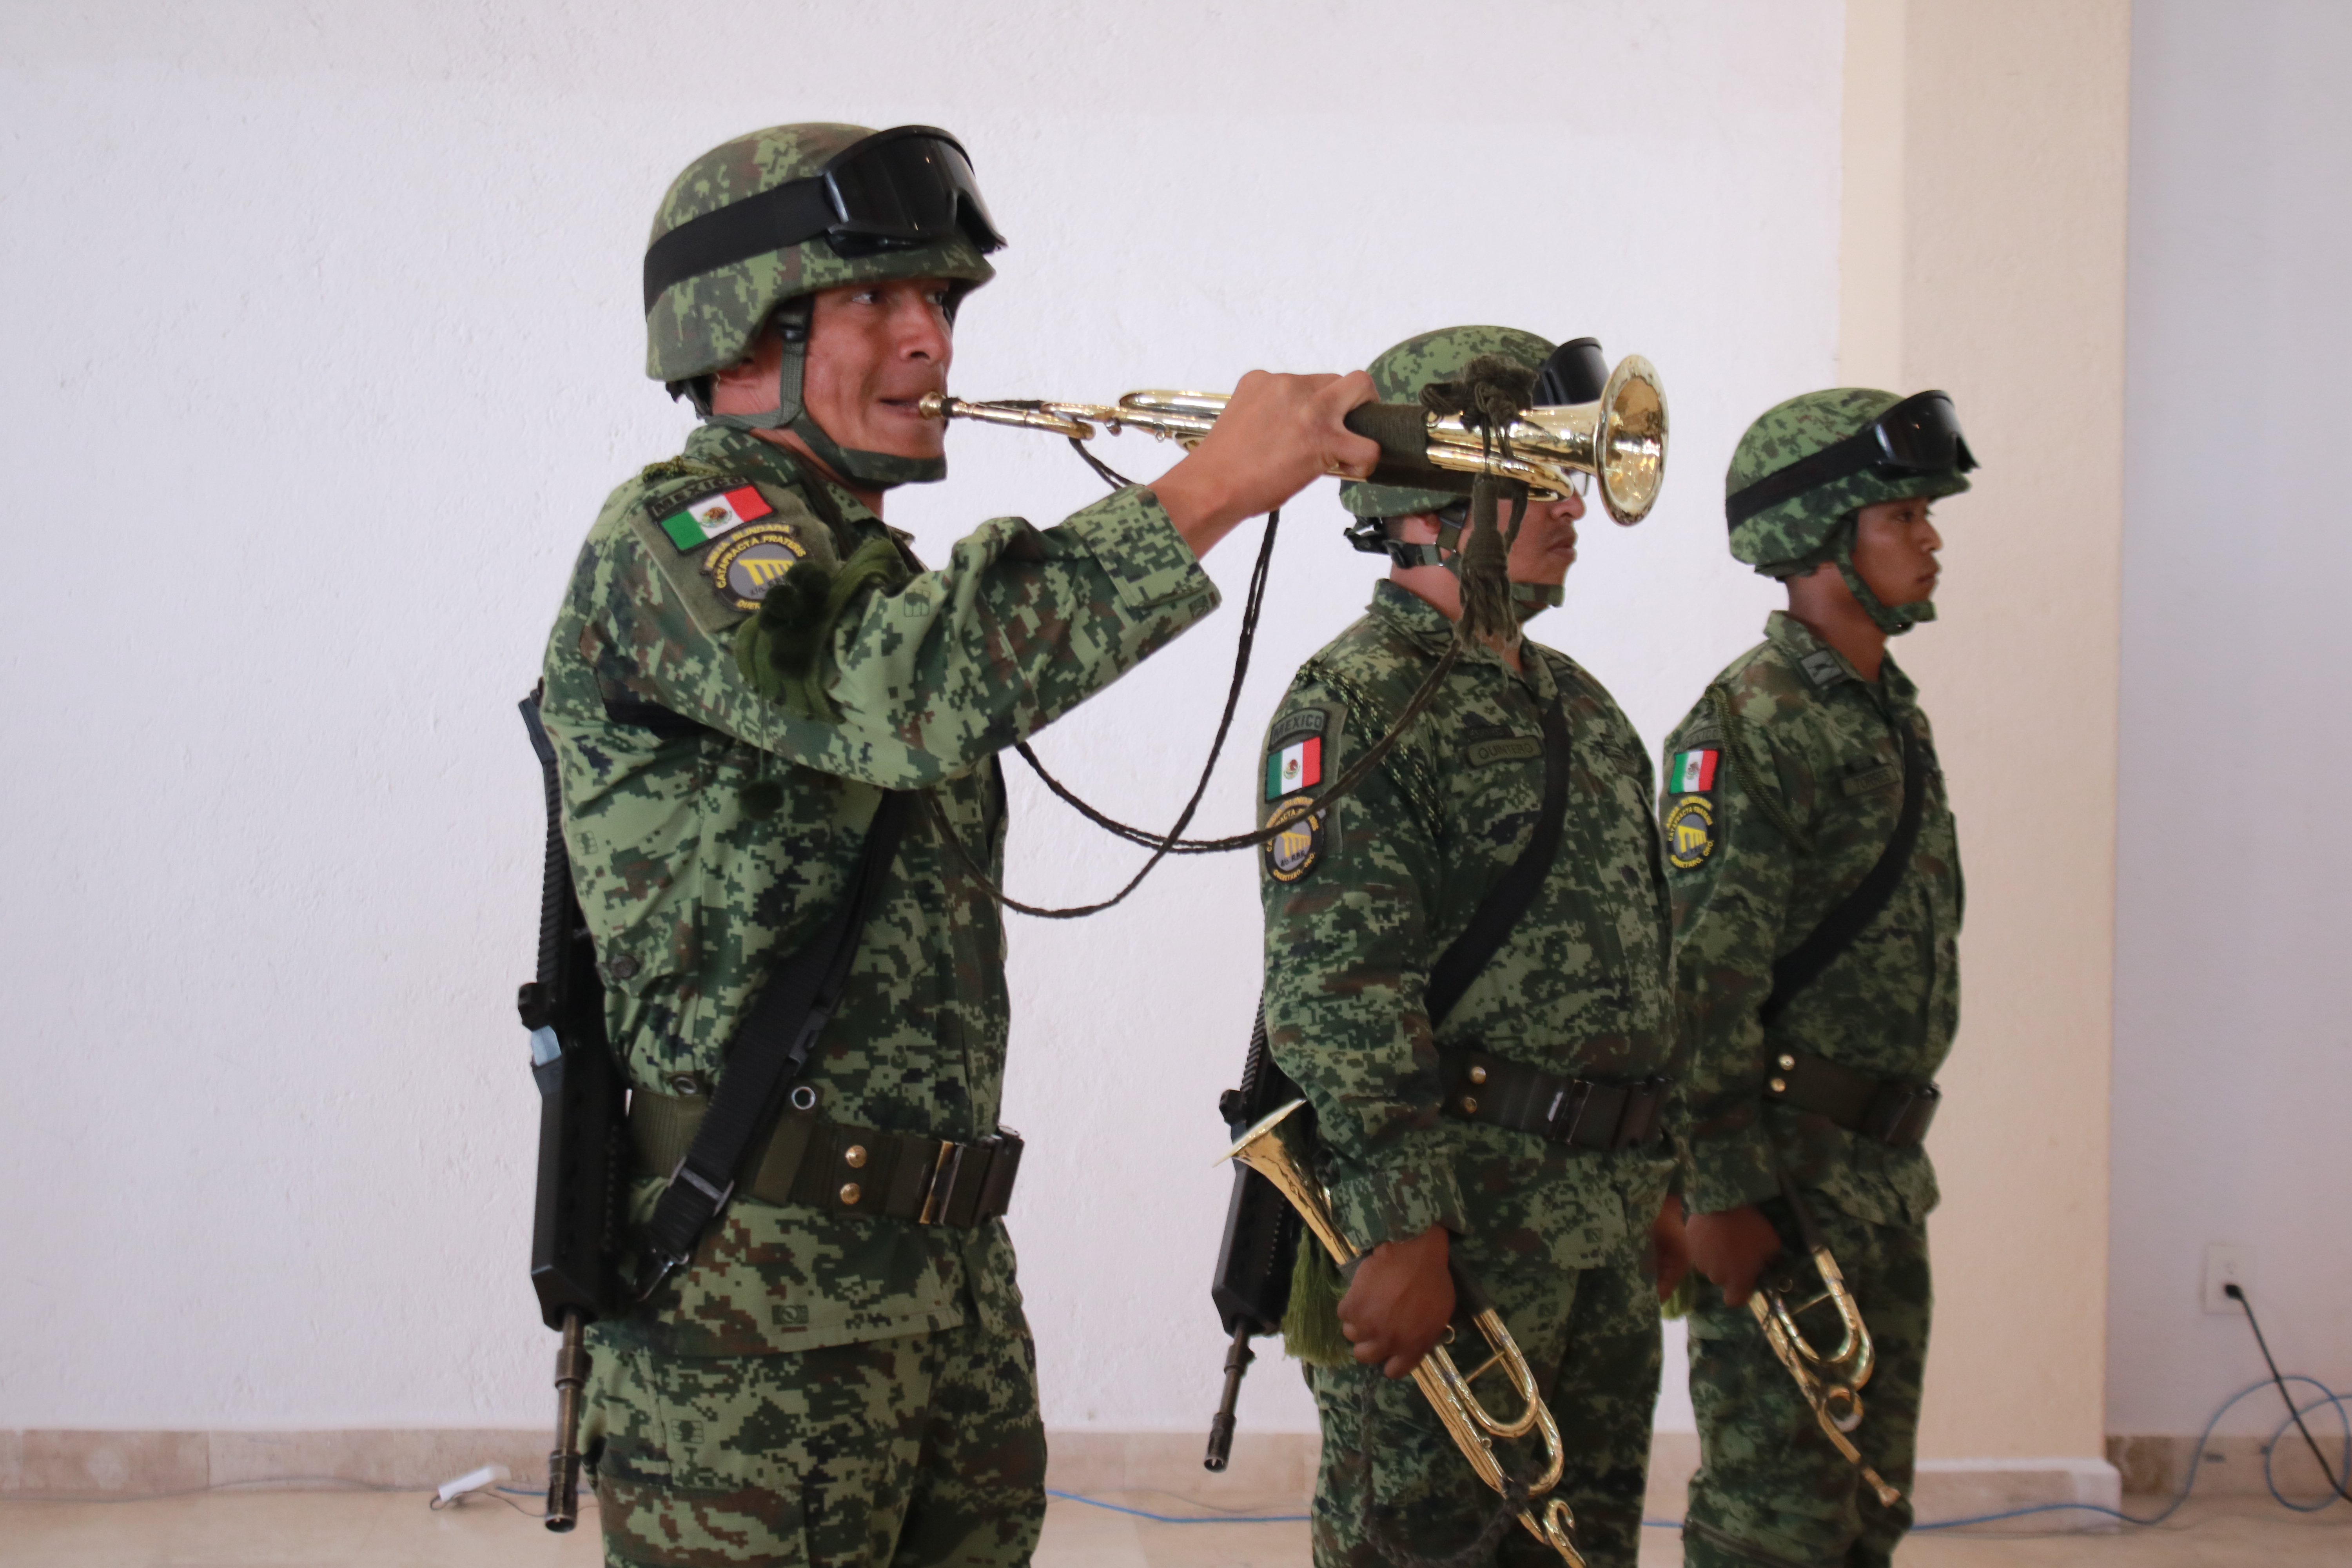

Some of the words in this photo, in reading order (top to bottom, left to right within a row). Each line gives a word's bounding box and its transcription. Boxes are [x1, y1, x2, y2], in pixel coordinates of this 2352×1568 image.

[653, 477, 746, 515] MEXICO
[706, 541, 731, 568] ARMA
[731, 524, 790, 542] BLINDADA
[716, 537, 760, 588] CATAFRACTA
[762, 535, 806, 557] FRATERIS
[1273, 714, 1323, 741] MEXICO
[1666, 806, 1680, 828] ARMA
[1680, 796, 1712, 811] BLINDADA
[1668, 806, 1693, 841] CATAFRACTA
